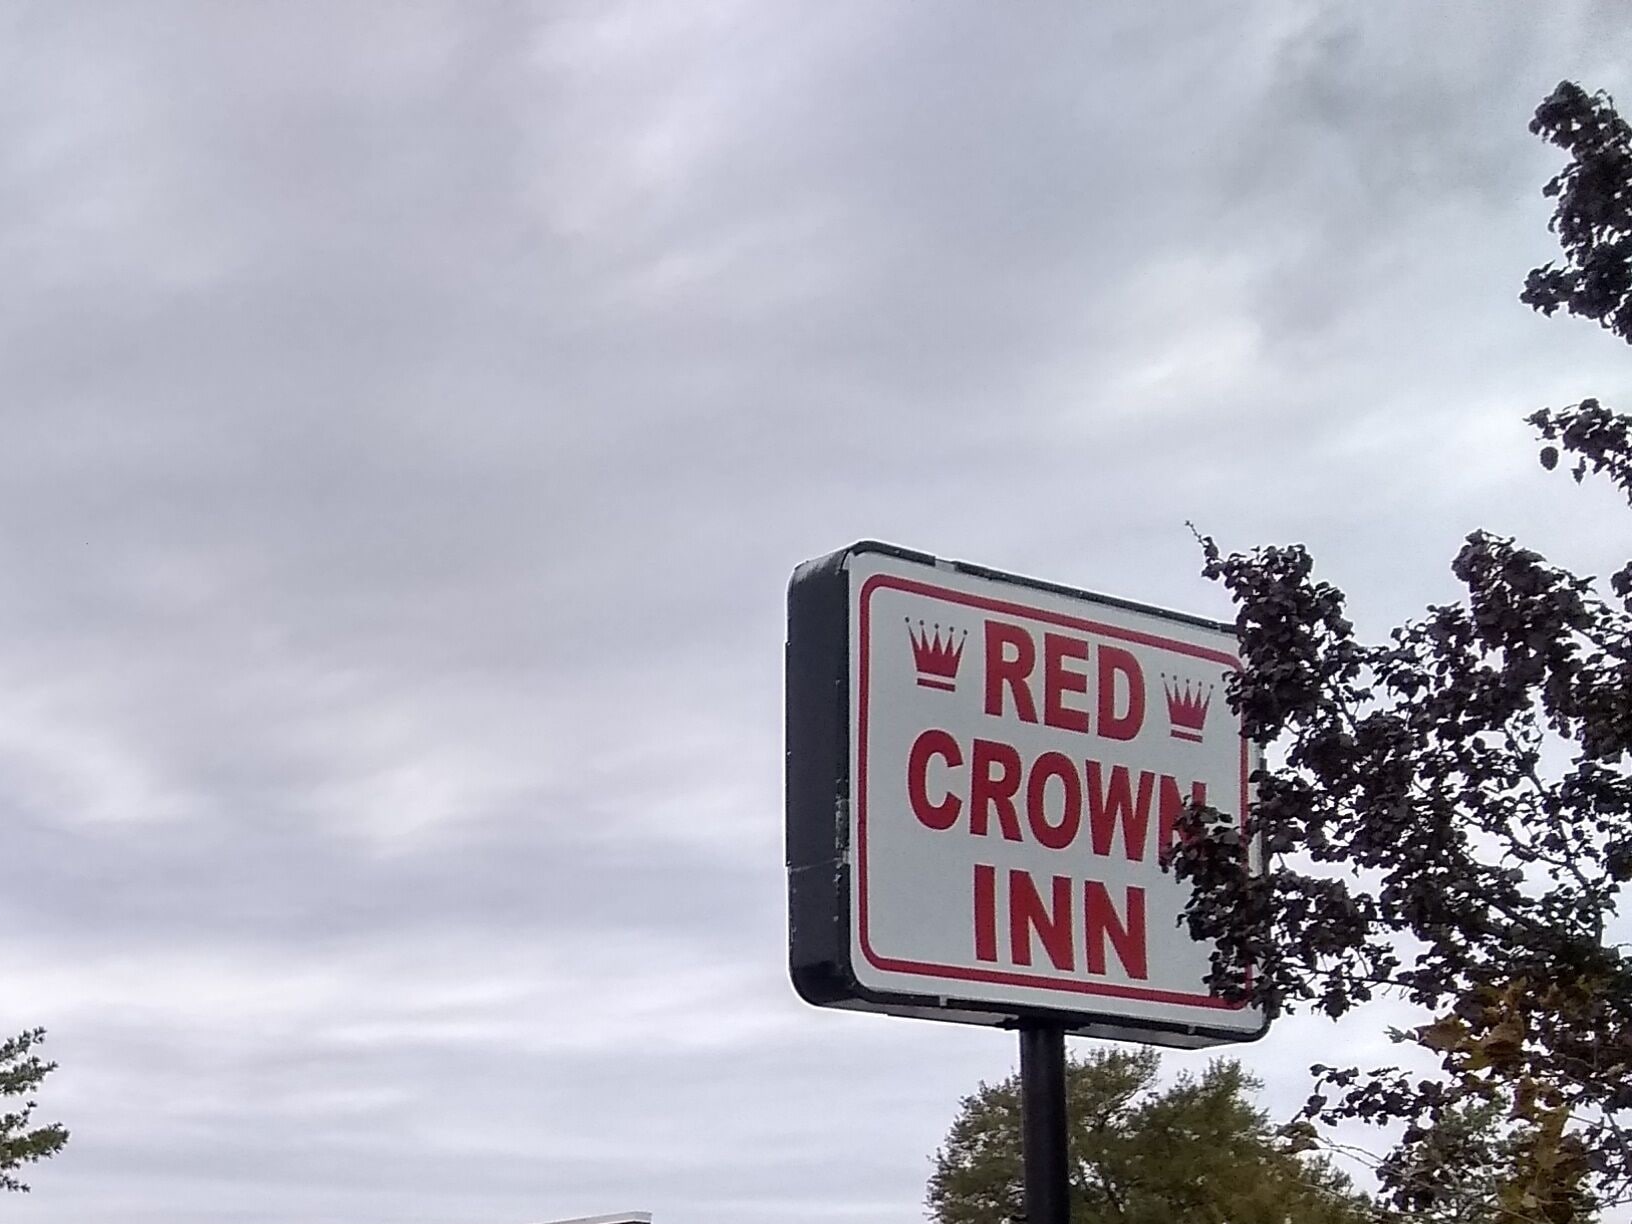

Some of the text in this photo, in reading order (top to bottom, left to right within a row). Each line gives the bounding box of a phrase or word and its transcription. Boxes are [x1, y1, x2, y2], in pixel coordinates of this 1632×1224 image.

[984, 619, 1146, 741] RED
[907, 729, 1208, 870] CROWN
[973, 864, 1148, 981] INN
